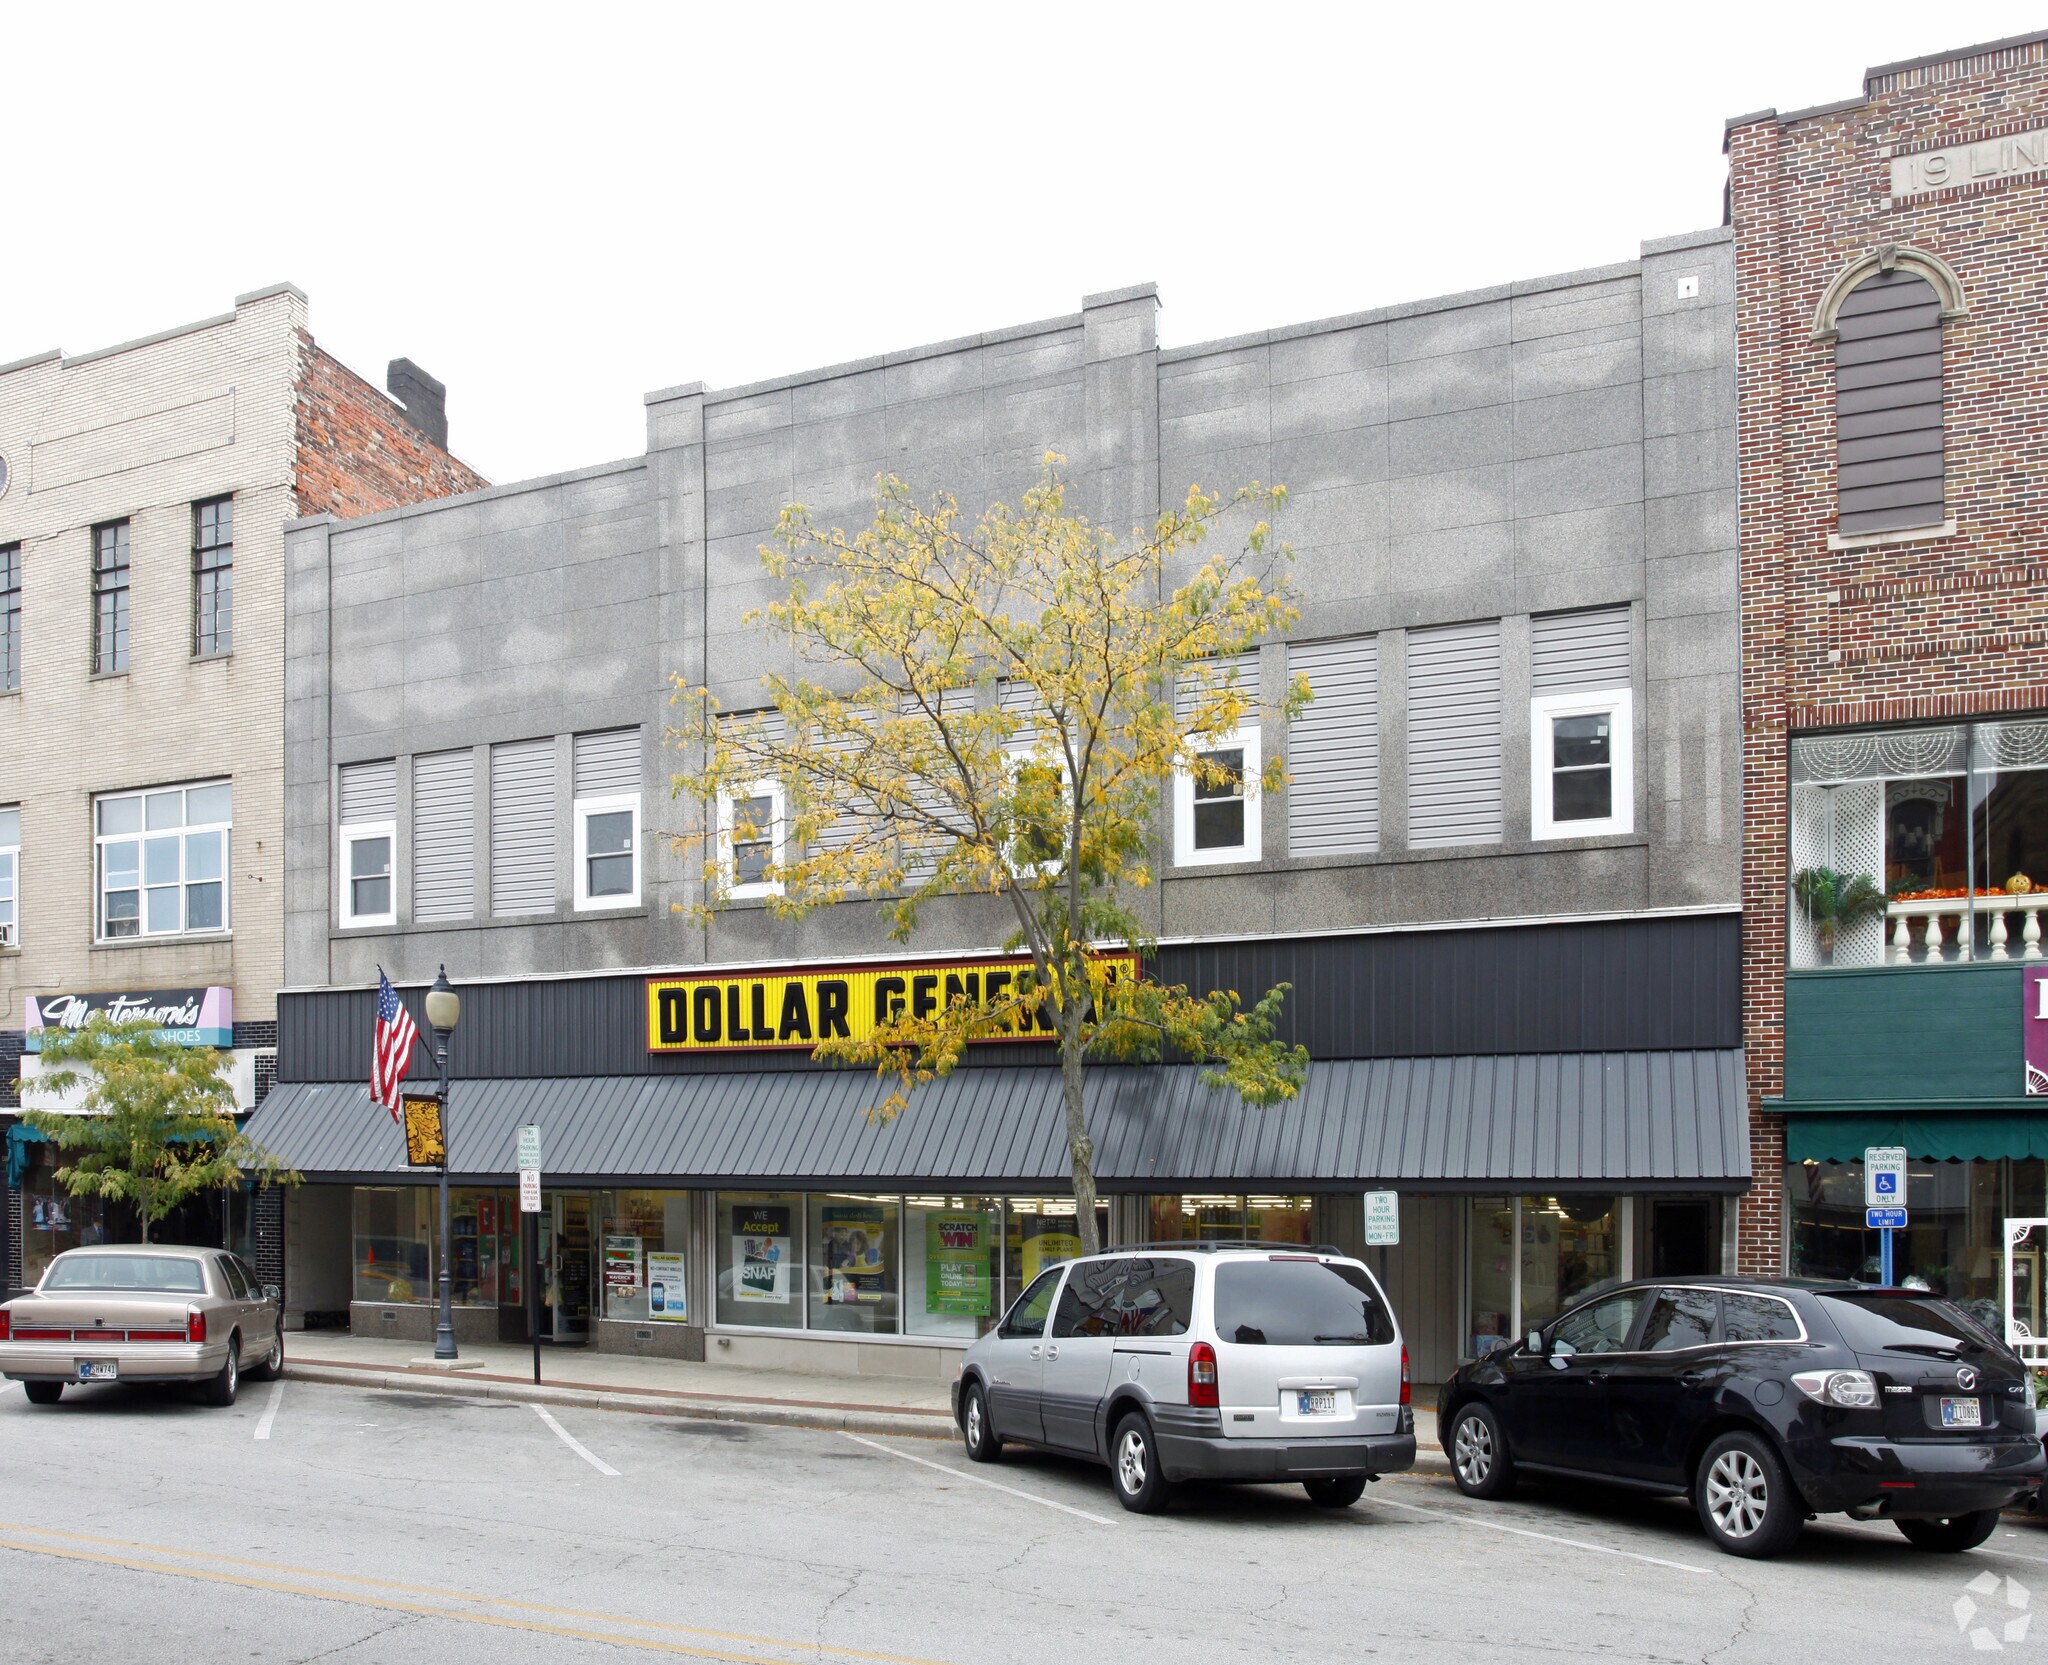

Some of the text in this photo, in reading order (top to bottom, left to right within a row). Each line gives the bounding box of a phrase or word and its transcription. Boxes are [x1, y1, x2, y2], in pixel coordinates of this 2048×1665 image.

[1910, 136, 2048, 191] 19 LIN
[658, 965, 1118, 1043] DOLLAR GENER
[161, 1030, 201, 1042] SHOES
[1869, 1153, 1903, 1161] RESERVED
[1870, 1163, 1900, 1171] PARKING
[527, 1174, 535, 1182] NO
[1375, 1196, 1387, 1204] TWO
[1876, 1195, 1895, 1203] ONLY
[1372, 1205, 1390, 1213] HOUR
[753, 1210, 768, 1220] WE
[1368, 1215, 1395, 1223] PARKING
[742, 1221, 779, 1234] Accept
[938, 1223, 978, 1231] SCRATCH
[1368, 1232, 1396, 1240] MON-FRI
[940, 1263, 961, 1271] PLAY
[742, 1266, 776, 1280] SNAP
[1310, 1397, 1335, 1410] RRP117
